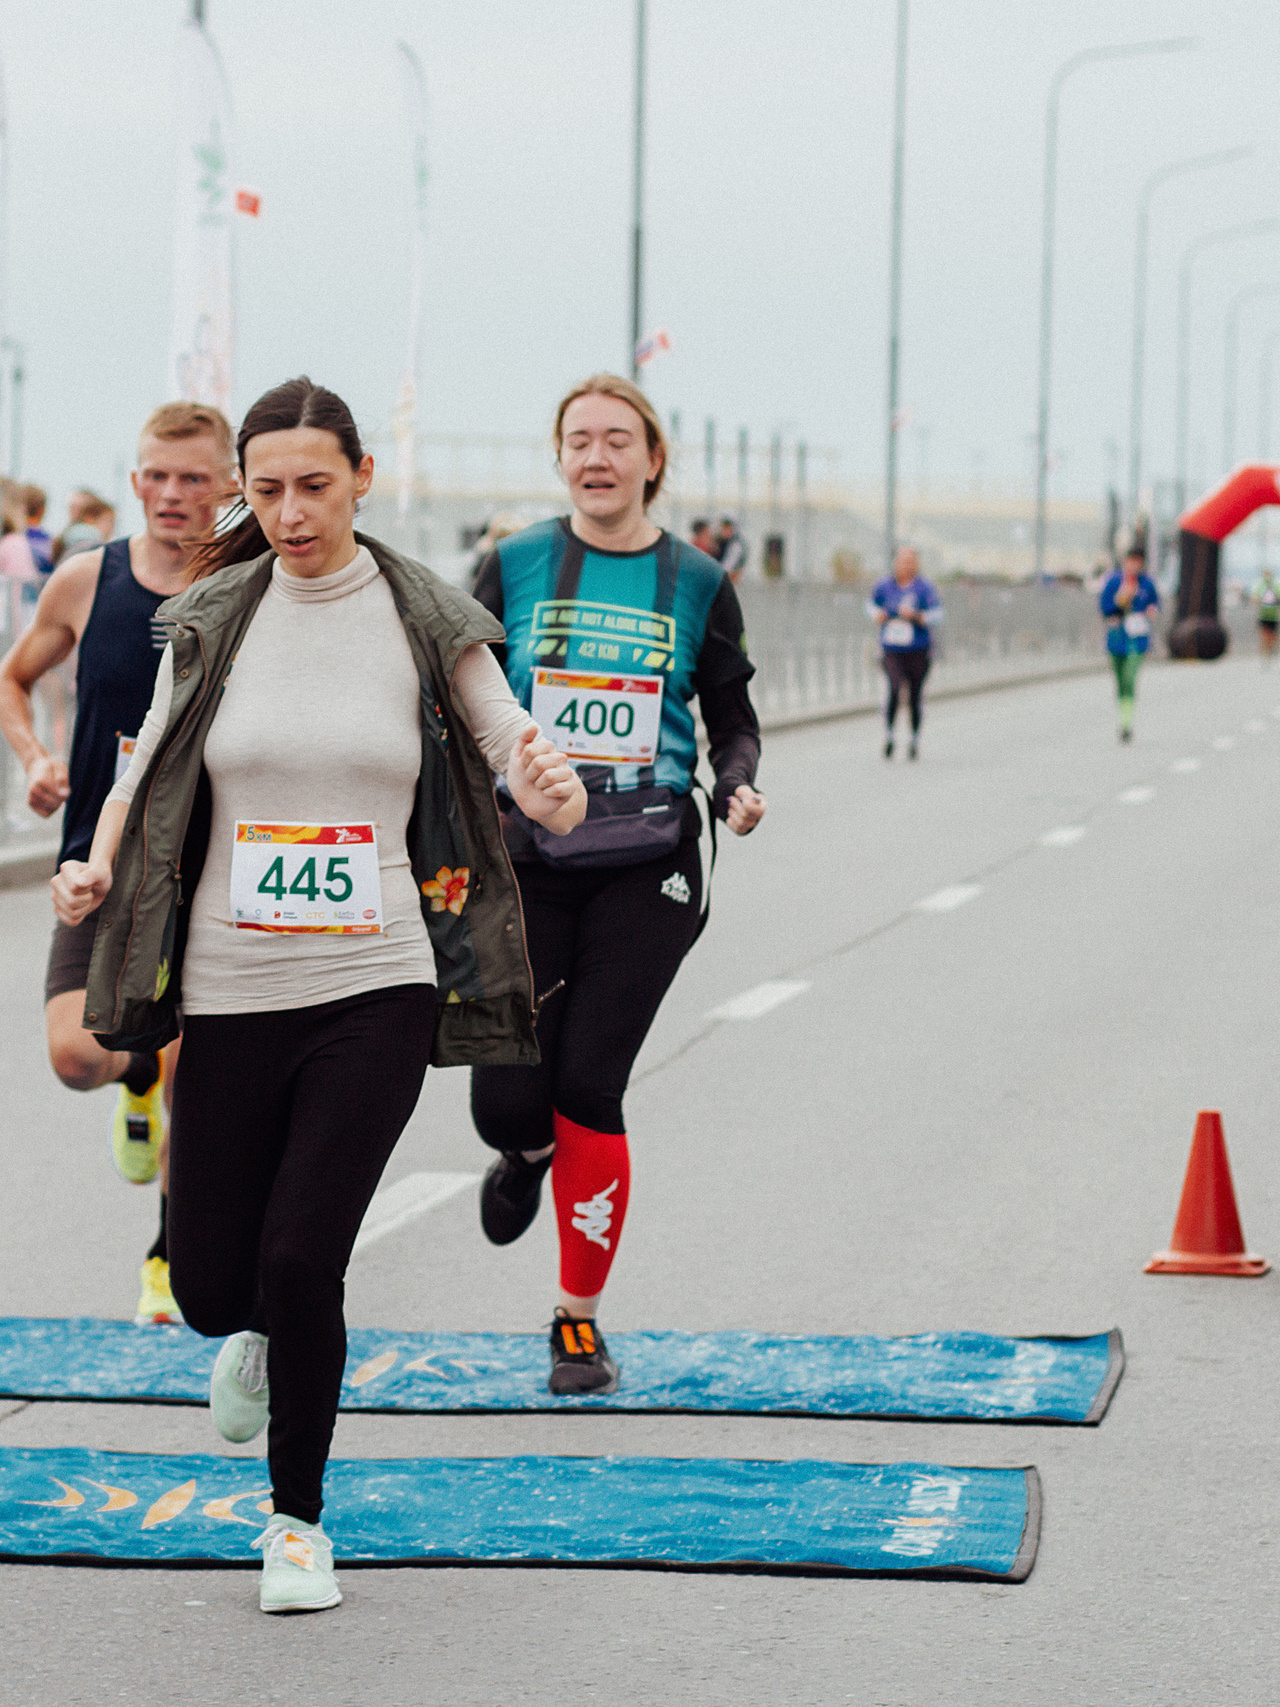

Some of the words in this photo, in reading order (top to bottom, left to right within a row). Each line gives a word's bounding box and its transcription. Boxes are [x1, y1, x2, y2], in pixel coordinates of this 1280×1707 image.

[578, 642, 595, 658] 42
[598, 643, 619, 660] KM
[554, 698, 635, 737] 400
[257, 855, 353, 903] 445
